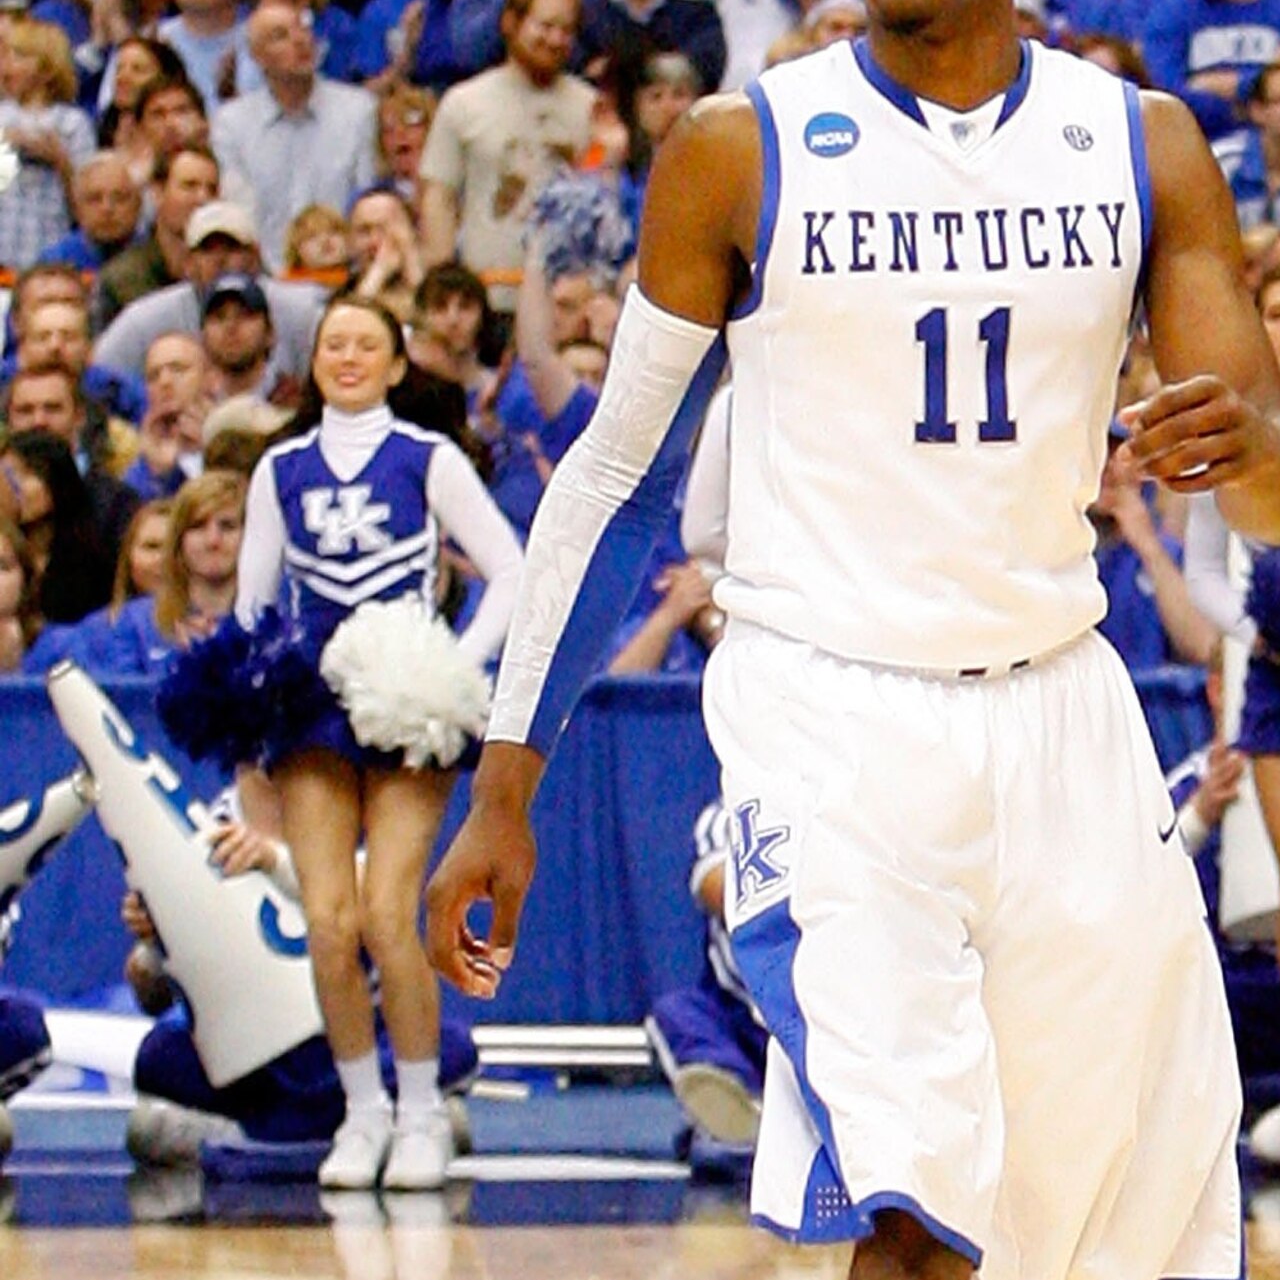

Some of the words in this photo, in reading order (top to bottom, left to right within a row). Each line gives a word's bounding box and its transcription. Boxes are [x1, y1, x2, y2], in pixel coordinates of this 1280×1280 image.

[810, 131, 853, 149] NCAA
[801, 201, 1126, 275] KENTUCKY
[913, 305, 1017, 443] 11
[301, 484, 394, 556] UK
